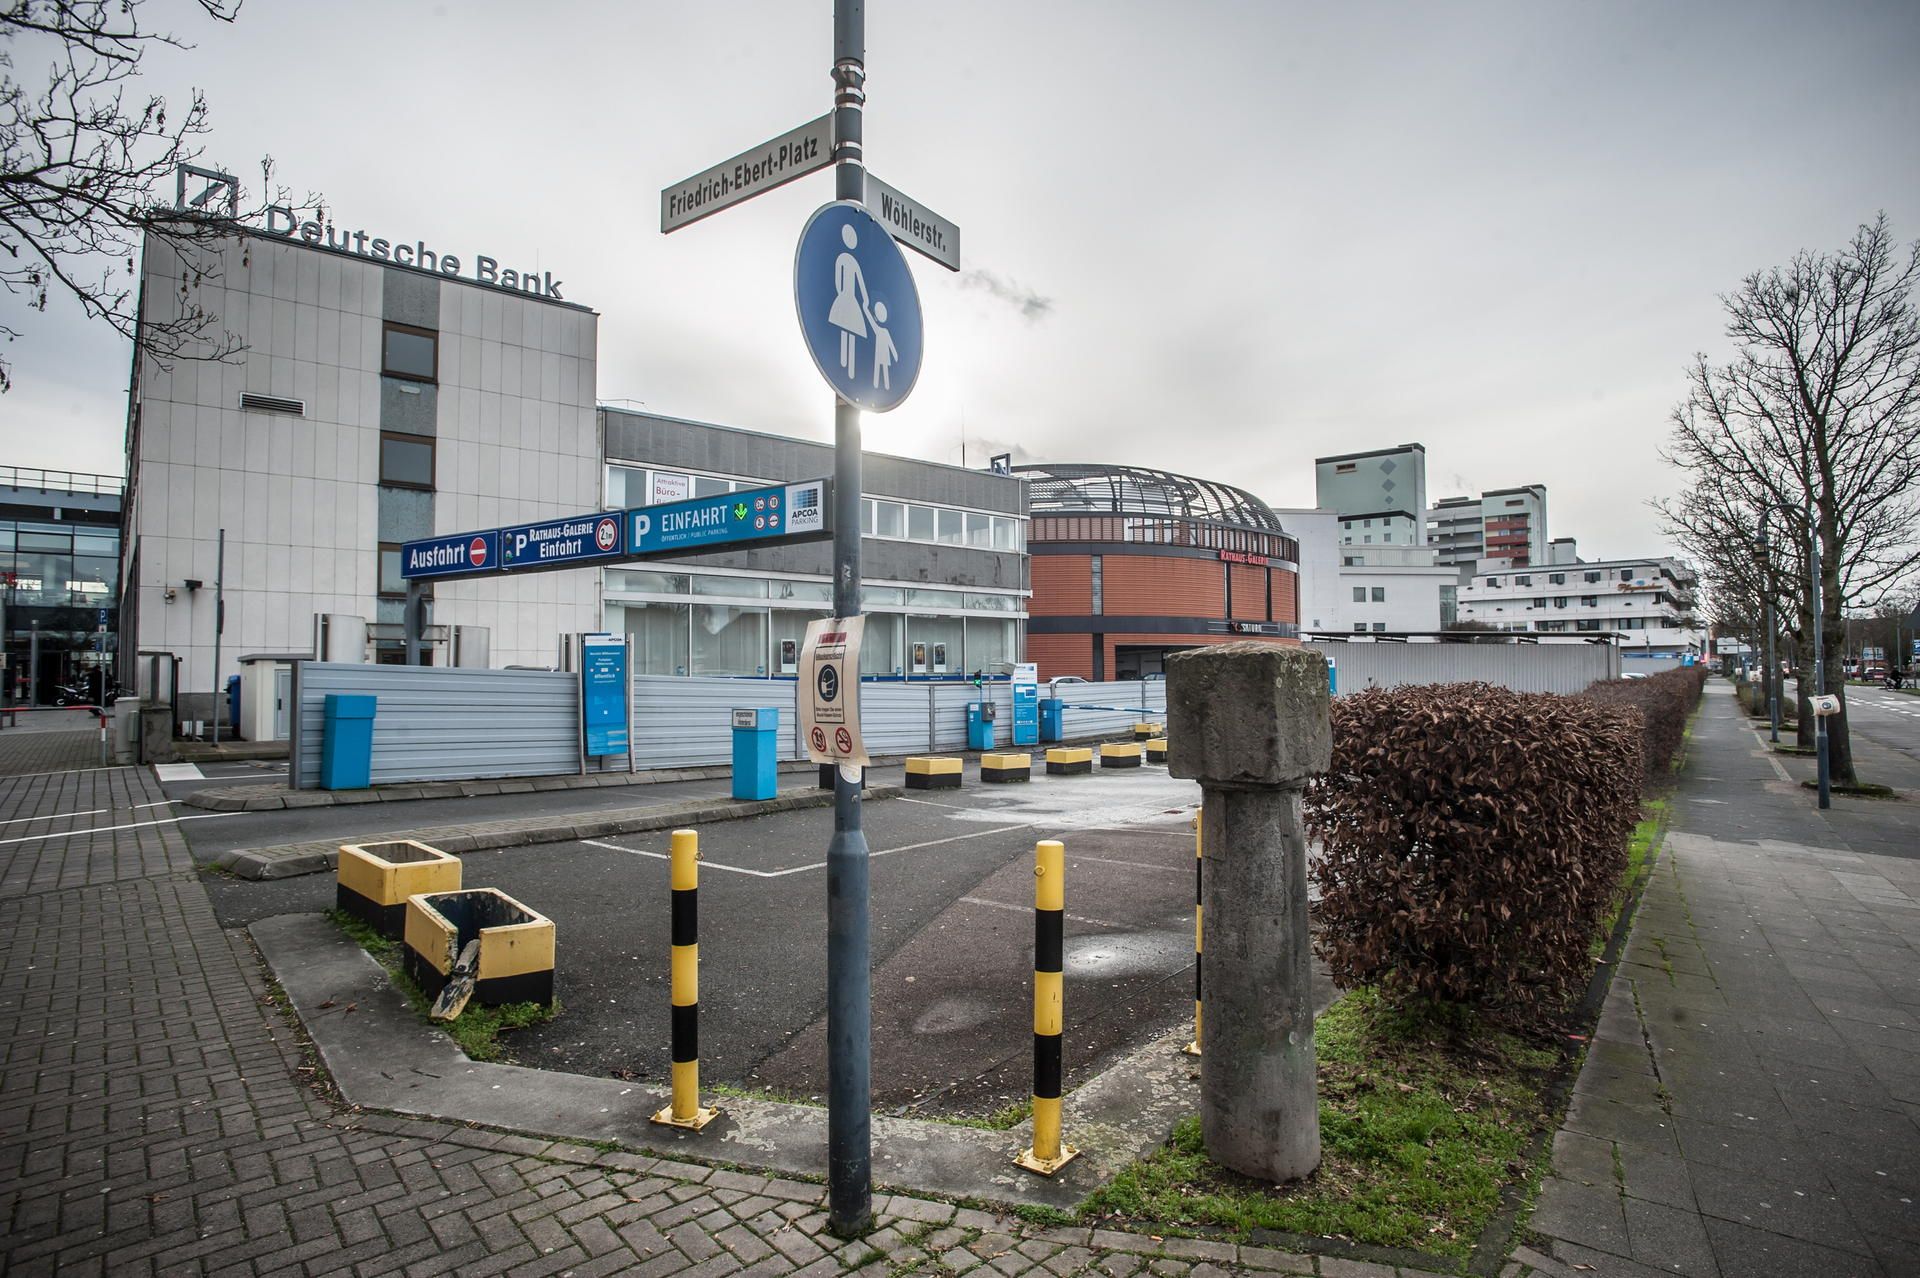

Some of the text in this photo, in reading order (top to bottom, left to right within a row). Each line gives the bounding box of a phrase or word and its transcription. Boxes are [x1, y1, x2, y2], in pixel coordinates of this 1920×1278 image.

[669, 136, 818, 218] Friedrich-Ebert-Platz
[881, 192, 946, 252] Wöhlerstr.
[267, 206, 564, 299] Deutsche Bank
[661, 505, 728, 532] EINFAHRT
[791, 508, 818, 519] APCOA
[791, 516, 819, 527] PARKING
[529, 522, 594, 542] RATHAUS-GALERIE
[635, 514, 650, 547] P
[410, 543, 465, 569] Ausfahrt
[515, 534, 527, 557] P
[540, 538, 582, 559] Einfahrt
